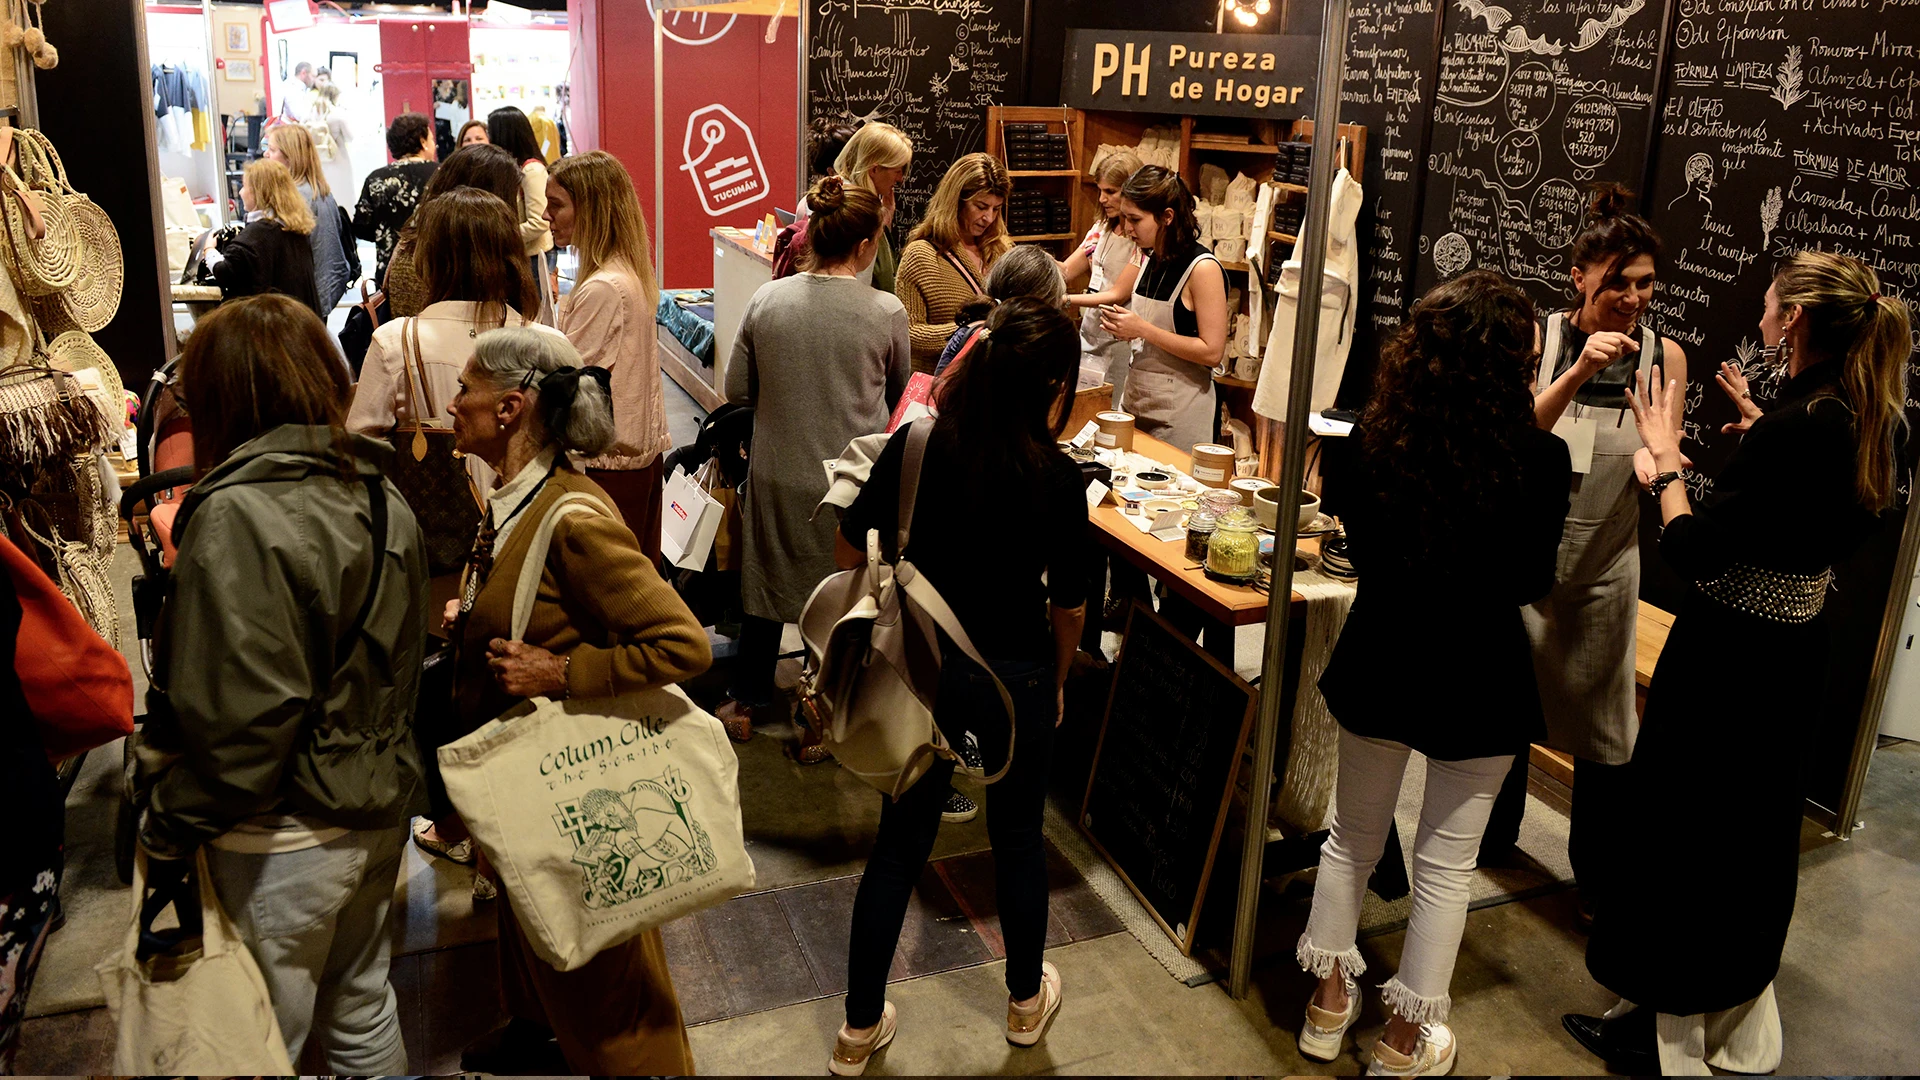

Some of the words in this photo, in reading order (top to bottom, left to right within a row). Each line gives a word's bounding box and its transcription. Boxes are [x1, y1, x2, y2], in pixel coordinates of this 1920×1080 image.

[970, 42, 994, 57] Plano
[1871, 30, 1914, 58] Mirra
[1092, 42, 1151, 96] PH
[1168, 44, 1276, 71] Pureza
[973, 93, 996, 107] SER
[1169, 76, 1203, 100] de
[1214, 79, 1304, 108] Hogar
[1577, 130, 1595, 144] 520
[1813, 115, 1884, 140] Activados
[1846, 157, 1866, 176] DE
[1867, 161, 1911, 188] AMOR
[713, 180, 758, 203] TUCUMÁN
[1222, 242, 1233, 252] PH
[1874, 223, 1914, 247] Mirra
[1237, 465, 1248, 475] PH
[540, 735, 616, 776] Colum
[620, 715, 670, 746] Cille
